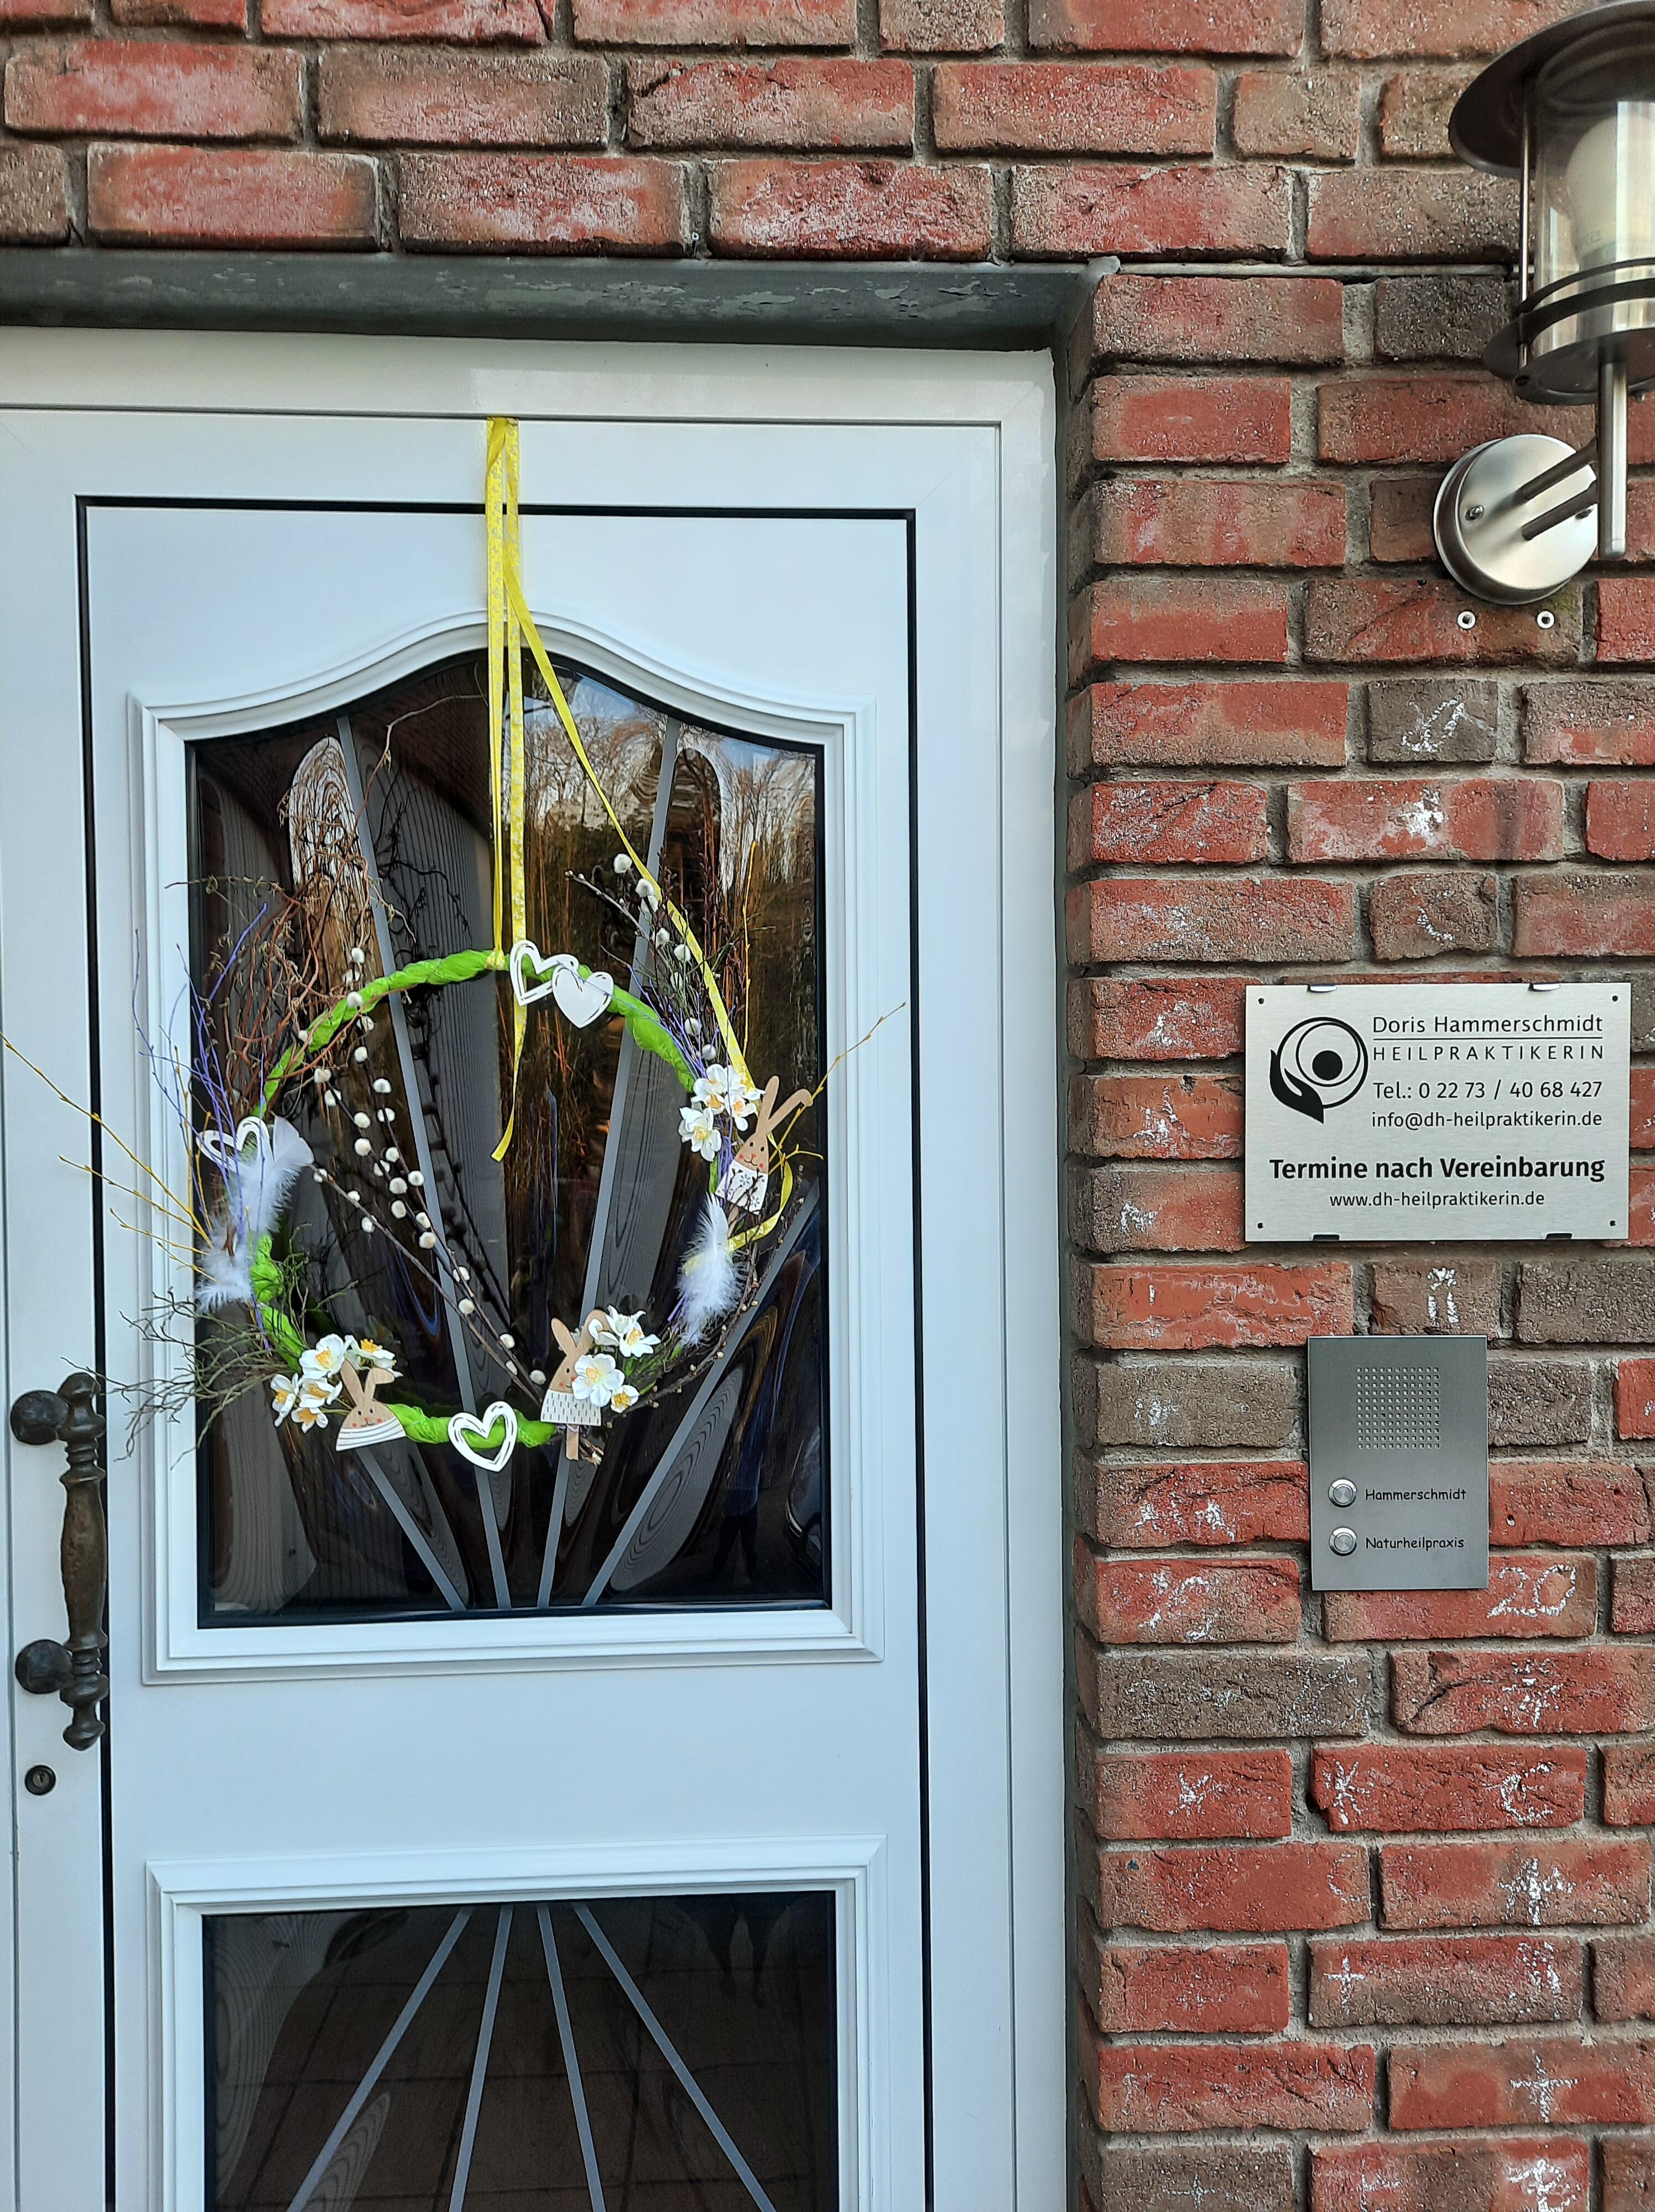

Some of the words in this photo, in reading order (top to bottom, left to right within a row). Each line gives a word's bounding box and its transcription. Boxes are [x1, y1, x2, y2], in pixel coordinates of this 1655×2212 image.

[1373, 1016, 1425, 1033] Doris
[1435, 1014, 1603, 1032] Hammerschmidt
[1373, 1045, 1602, 1061] HEILPRAKTIKERIN
[1373, 1081, 1412, 1099] Tel.:
[1419, 1082, 1430, 1099] 0
[1437, 1082, 1458, 1098] 22
[1465, 1082, 1485, 1098] 73
[1493, 1079, 1501, 1100] /
[1510, 1082, 1533, 1098] 40
[1540, 1081, 1563, 1098] 68
[1570, 1081, 1602, 1097] 427
[1372, 1110, 1602, 1131] info@dh-heilpraktikerin.de
[1269, 1156, 1368, 1179] Termine
[1376, 1156, 1433, 1178] nach
[1439, 1155, 1605, 1182] Vereinbarung
[1330, 1190, 1544, 1209] www.dh-heilpraktikerin.de
[1365, 1488, 1466, 1501] Hammerschmidt
[1366, 1536, 1464, 1552] Naturheilpraxis
